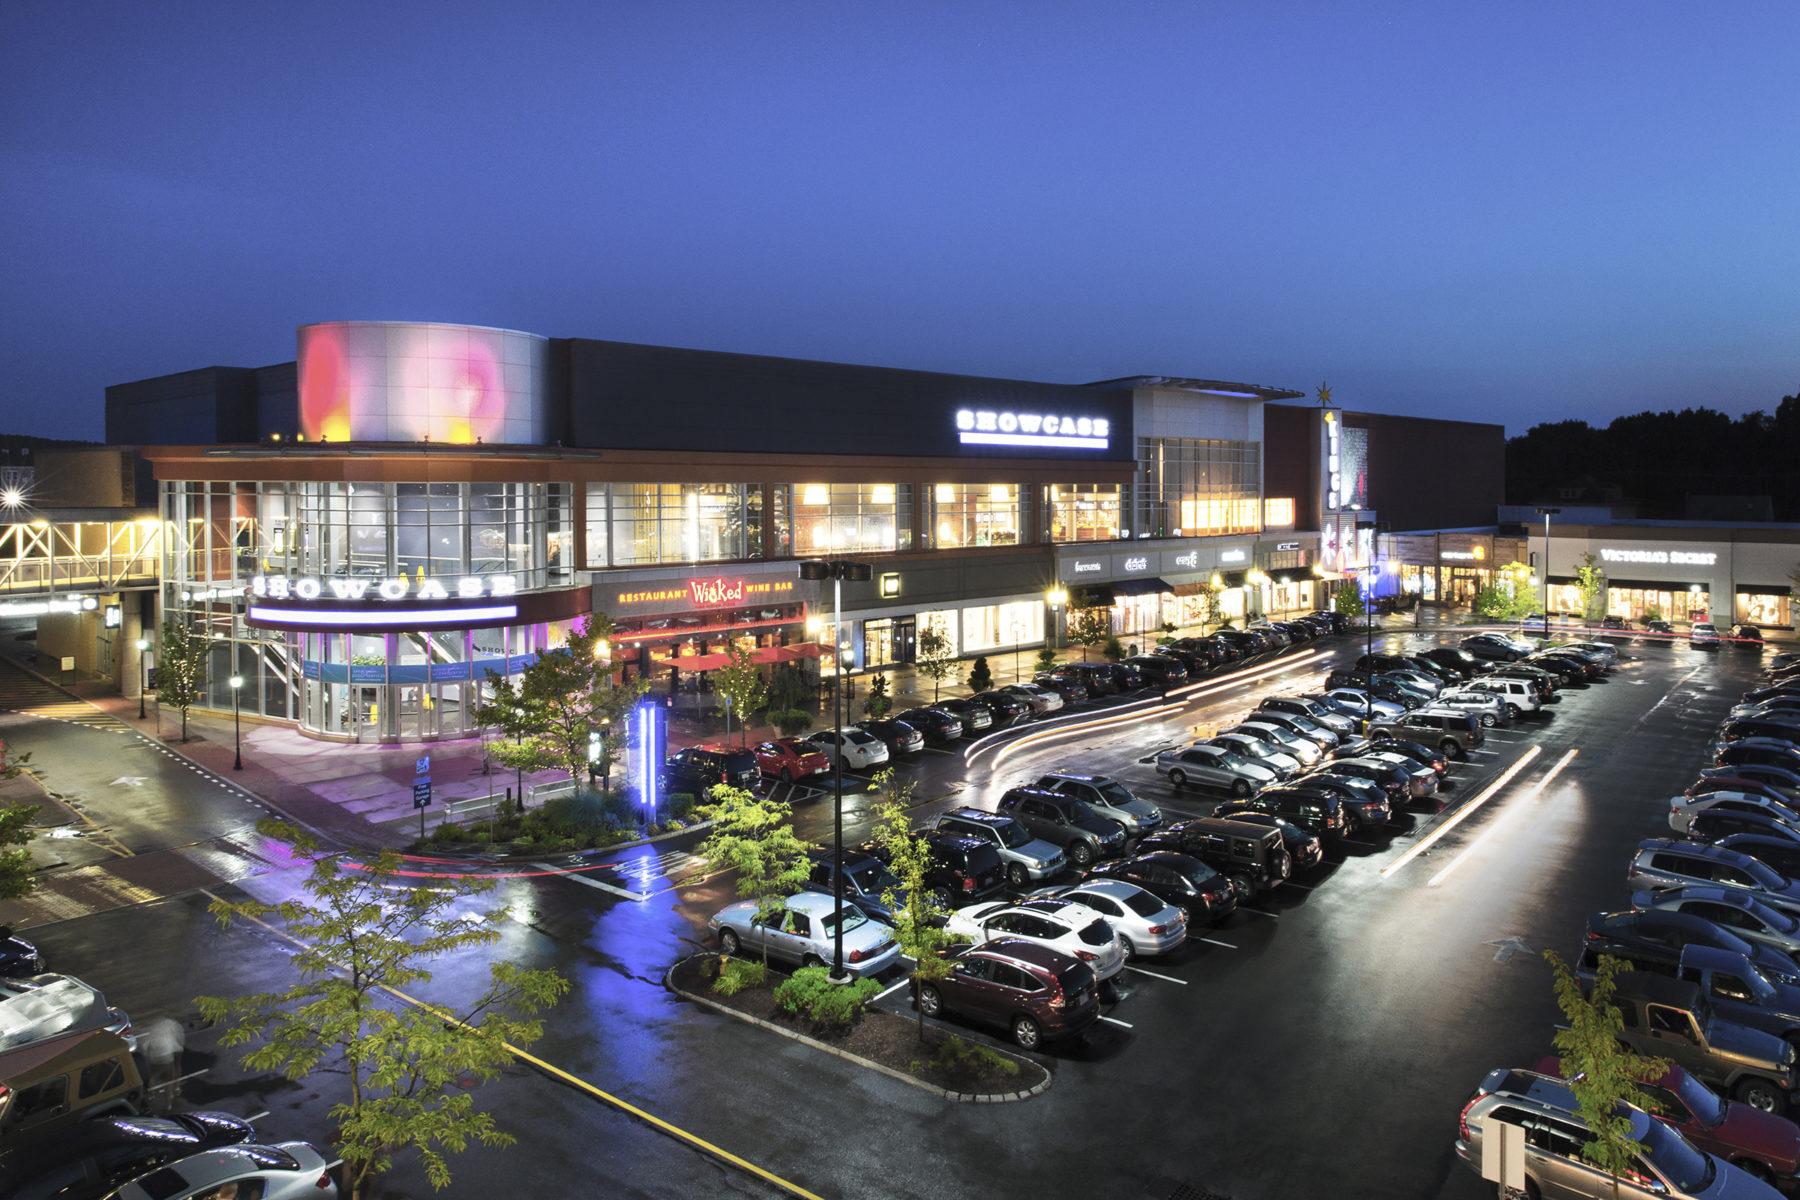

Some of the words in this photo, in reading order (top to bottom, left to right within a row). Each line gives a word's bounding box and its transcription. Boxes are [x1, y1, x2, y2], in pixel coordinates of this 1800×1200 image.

[956, 409, 1109, 437] SHOWCASE
[1600, 548, 1669, 564] VICTORIA'S
[1670, 551, 1717, 566] SECRET
[252, 576, 517, 599] SHOWCASE
[618, 589, 688, 603] RESTAURANT
[690, 578, 743, 603] Wicked
[745, 582, 771, 593] WINE
[775, 581, 793, 591] BAR
